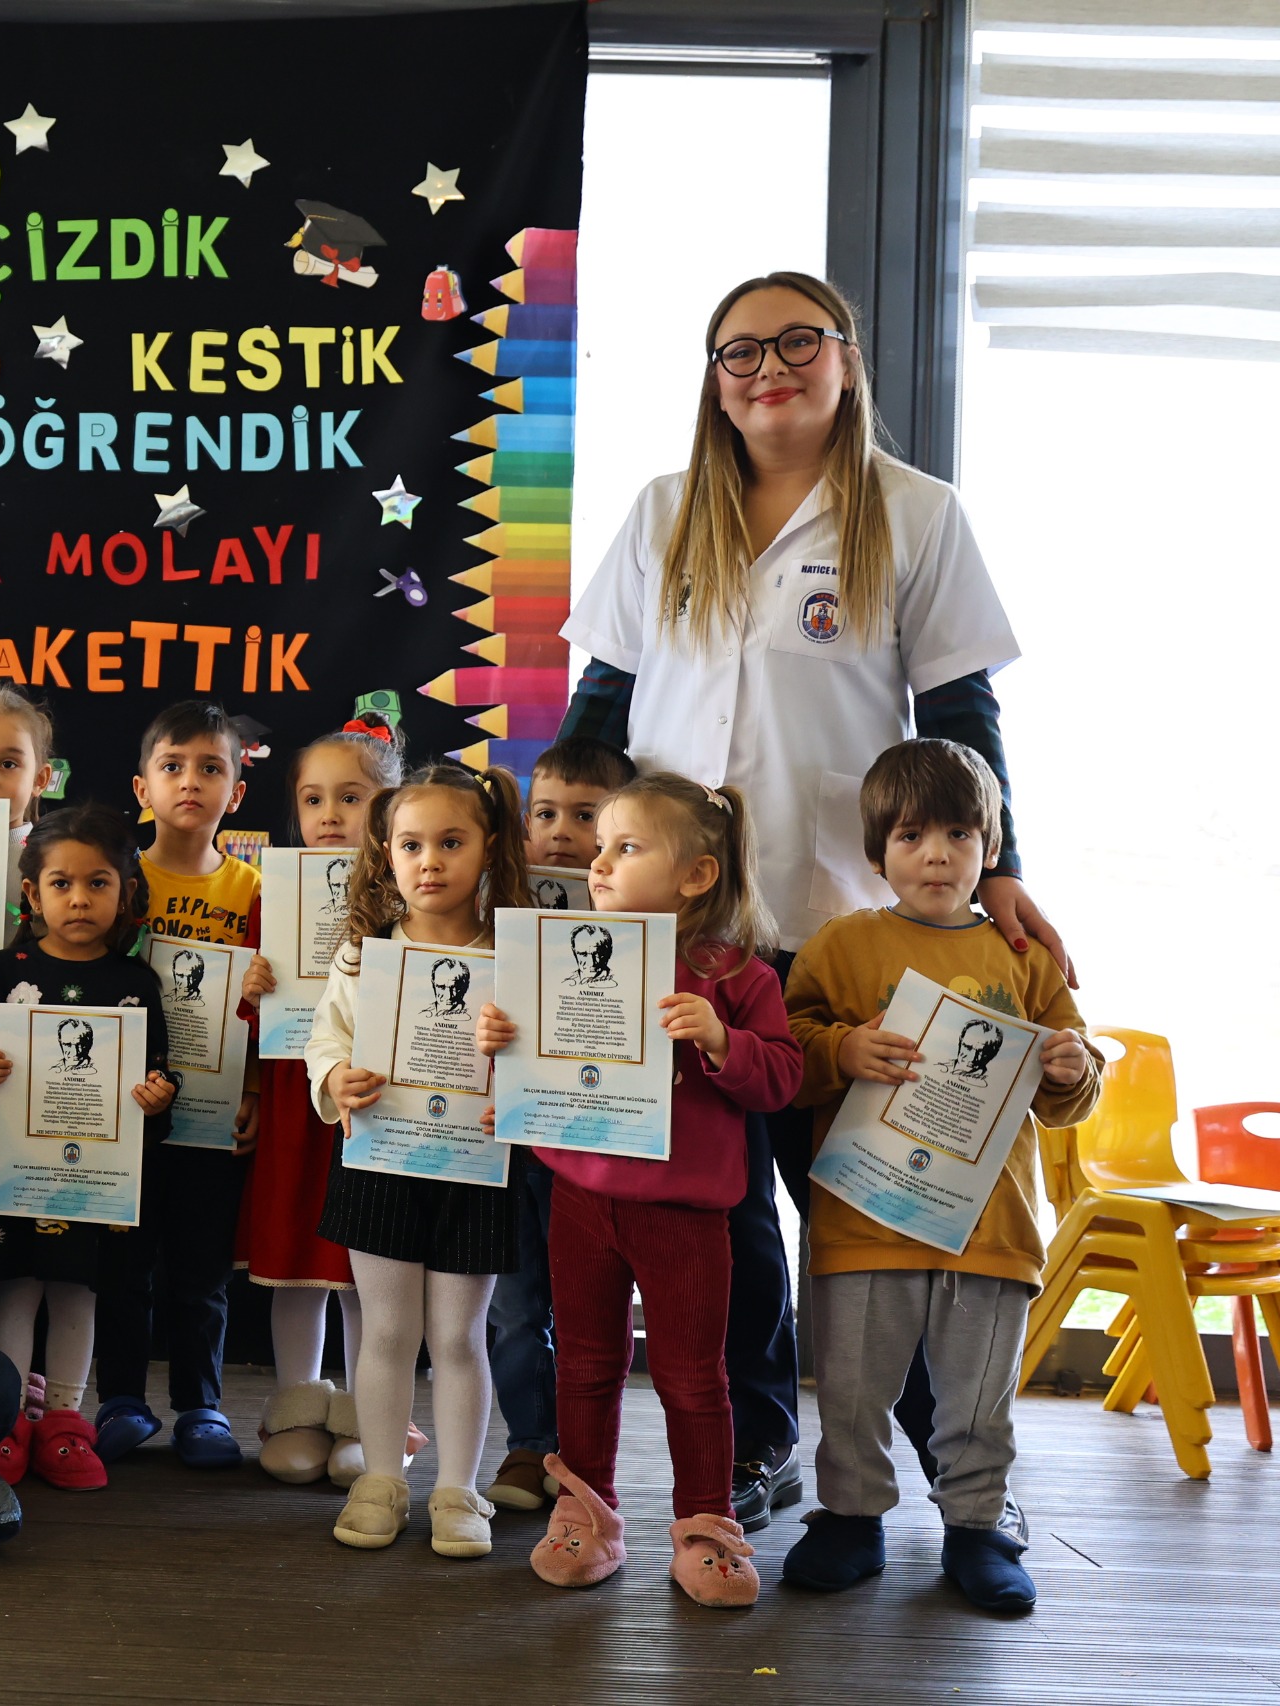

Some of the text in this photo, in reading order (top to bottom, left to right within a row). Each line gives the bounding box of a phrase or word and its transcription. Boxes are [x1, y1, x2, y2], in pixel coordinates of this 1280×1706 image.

[46, 523, 320, 585] MOLAYI
[801, 564, 830, 574] HATİCE
[146, 916, 210, 938] OND the
[166, 896, 247, 934] EXPLORE
